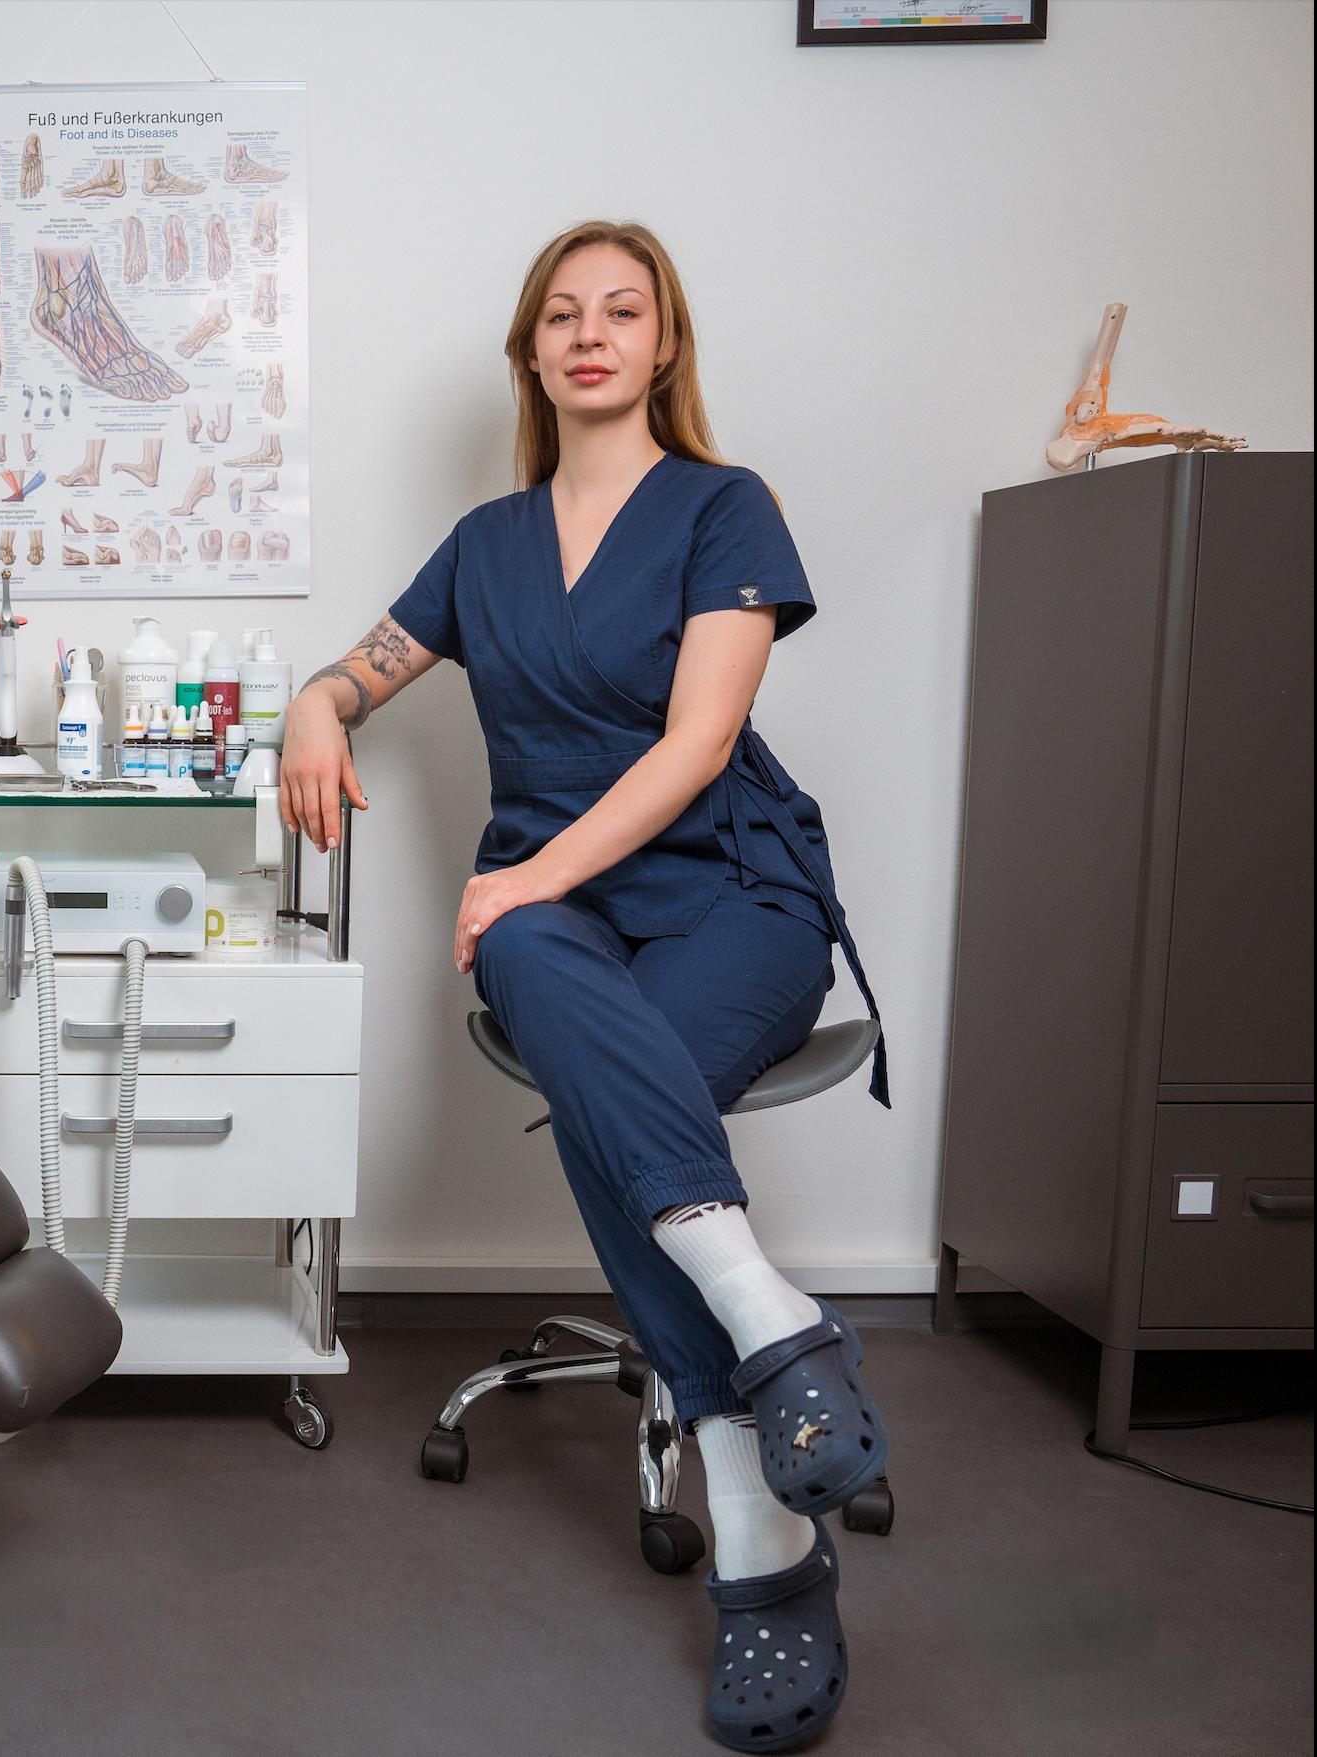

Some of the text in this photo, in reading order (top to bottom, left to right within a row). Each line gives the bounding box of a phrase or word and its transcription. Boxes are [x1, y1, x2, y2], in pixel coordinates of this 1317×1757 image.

[28, 110, 223, 127] Fuß und Fußerkrankungen
[59, 128, 178, 140] Foot and its Diseases
